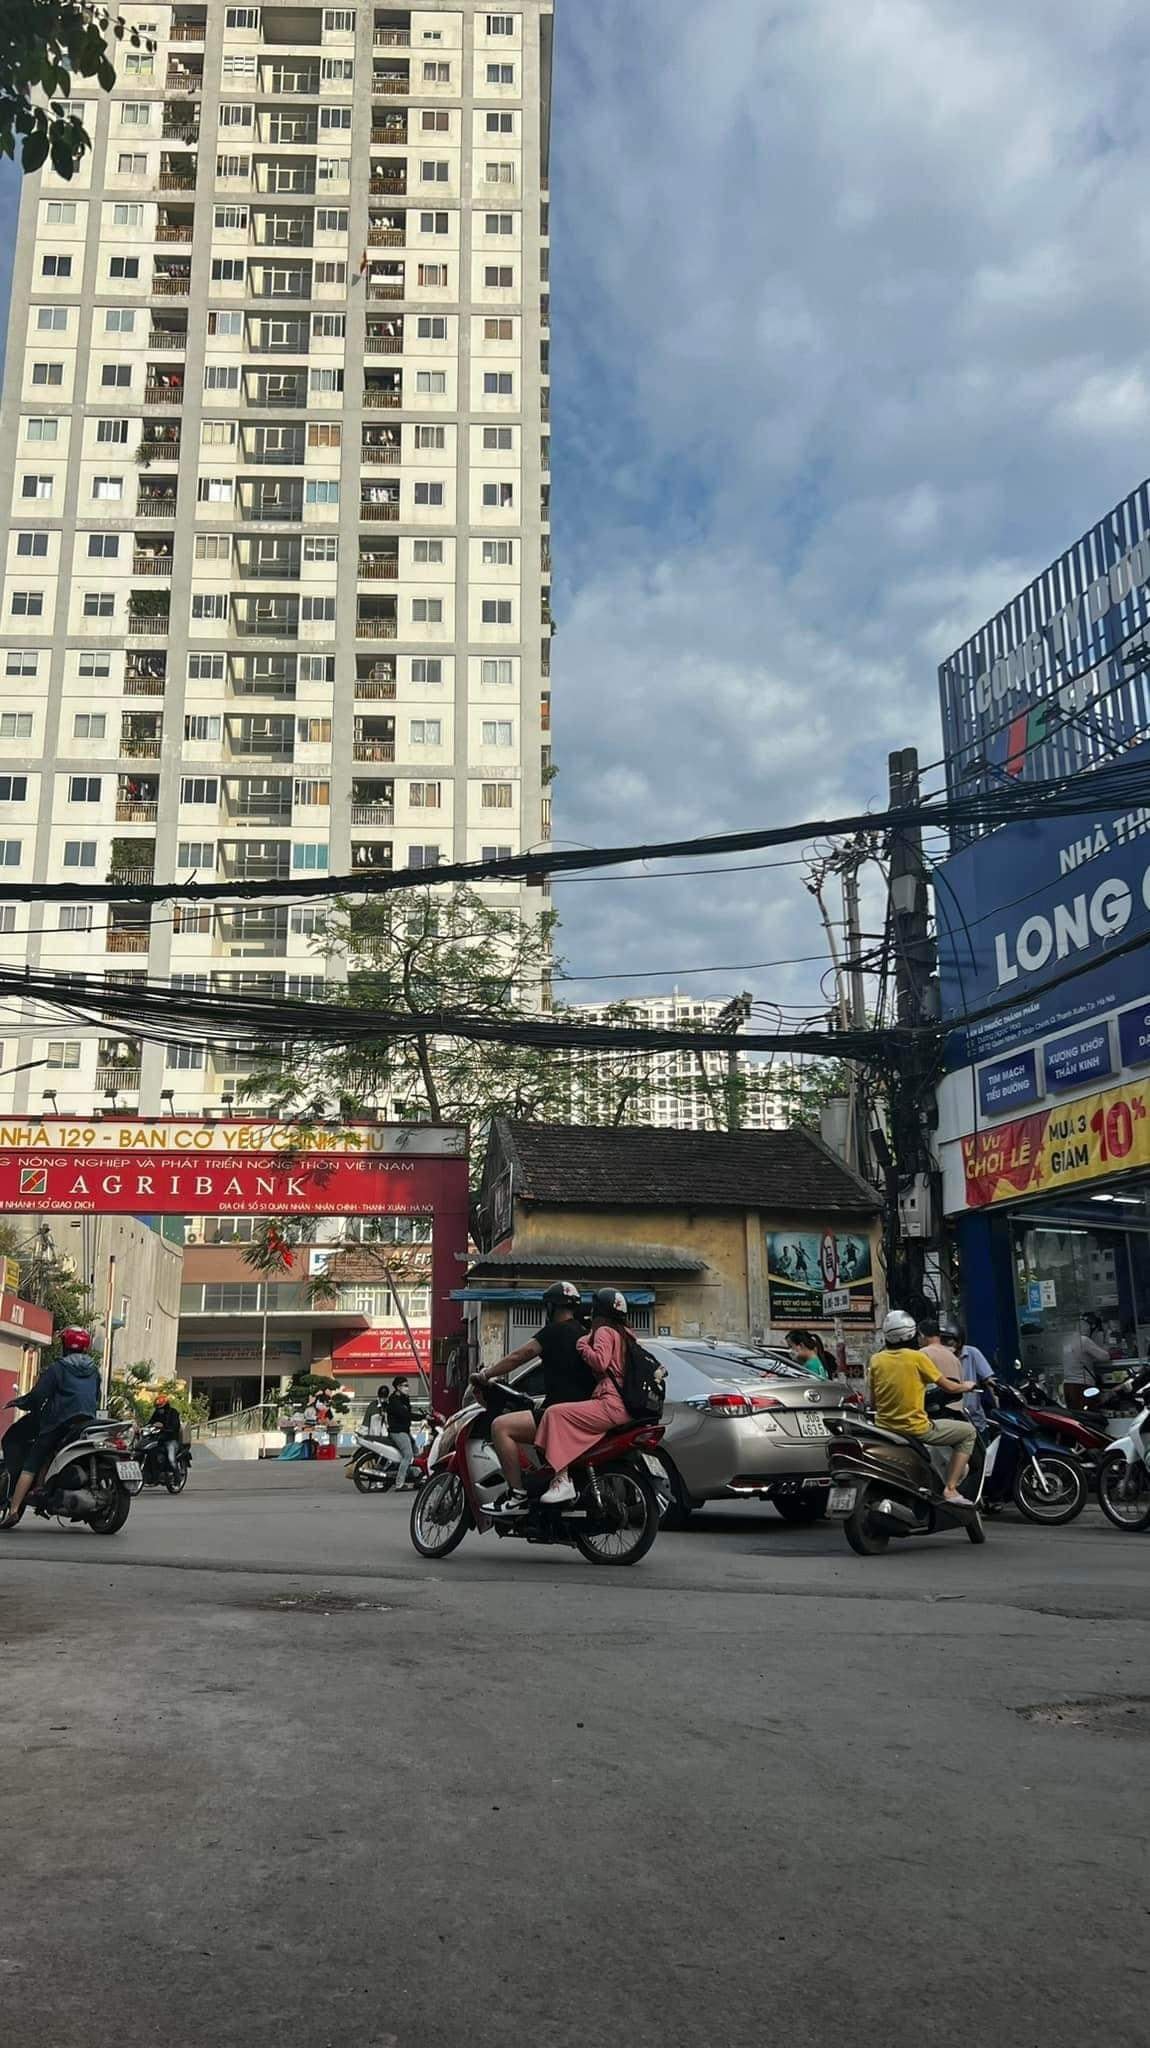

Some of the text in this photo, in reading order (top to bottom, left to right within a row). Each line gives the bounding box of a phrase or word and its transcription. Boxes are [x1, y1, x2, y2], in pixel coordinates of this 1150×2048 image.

[1059, 824, 1111, 875] NHÀ
[995, 878, 1132, 986] LONG
[1079, 1056, 1100, 1071] KINH
[988, 1074, 1001, 1085] TIM
[58, 1128, 96, 1147] 129
[120, 1129, 166, 1148] BAN
[174, 1130, 214, 1149] CƠ
[1049, 1115, 1087, 1142] MUA 3
[18, 1156, 68, 1167] NÔNG
[73, 1158, 131, 1169] NGHIỆP
[136, 1156, 156, 1168] VÀ
[161, 1156, 200, 1169] PHÁT
[247, 1158, 293, 1170] NÔNG
[300, 1159, 339, 1170] THÔN
[344, 1159, 373, 1171] VIỆT
[378, 1161, 415, 1171] NAM
[69, 1174, 306, 1196] AGRIBANK
